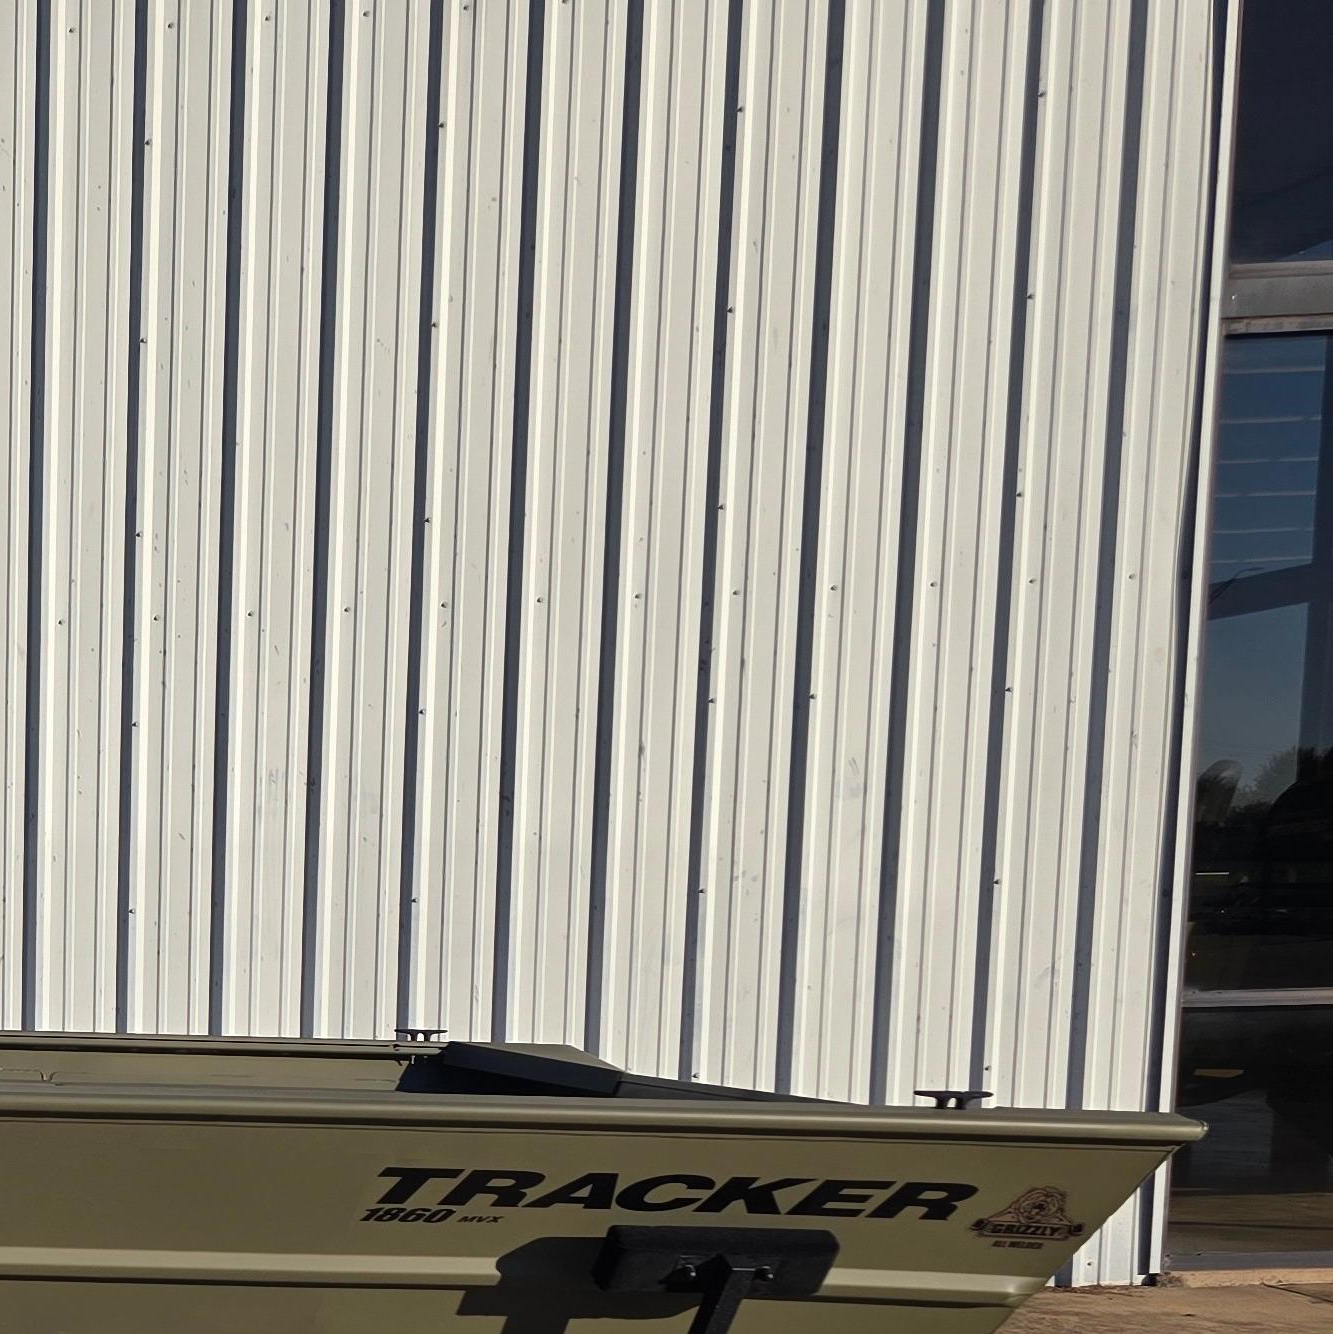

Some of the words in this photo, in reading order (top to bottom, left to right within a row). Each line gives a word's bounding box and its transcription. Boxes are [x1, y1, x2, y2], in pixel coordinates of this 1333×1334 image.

[376, 1167, 979, 1221] TRACKER
[360, 1207, 457, 1223] 1860
[992, 1223, 1061, 1236] GRIZZLY
